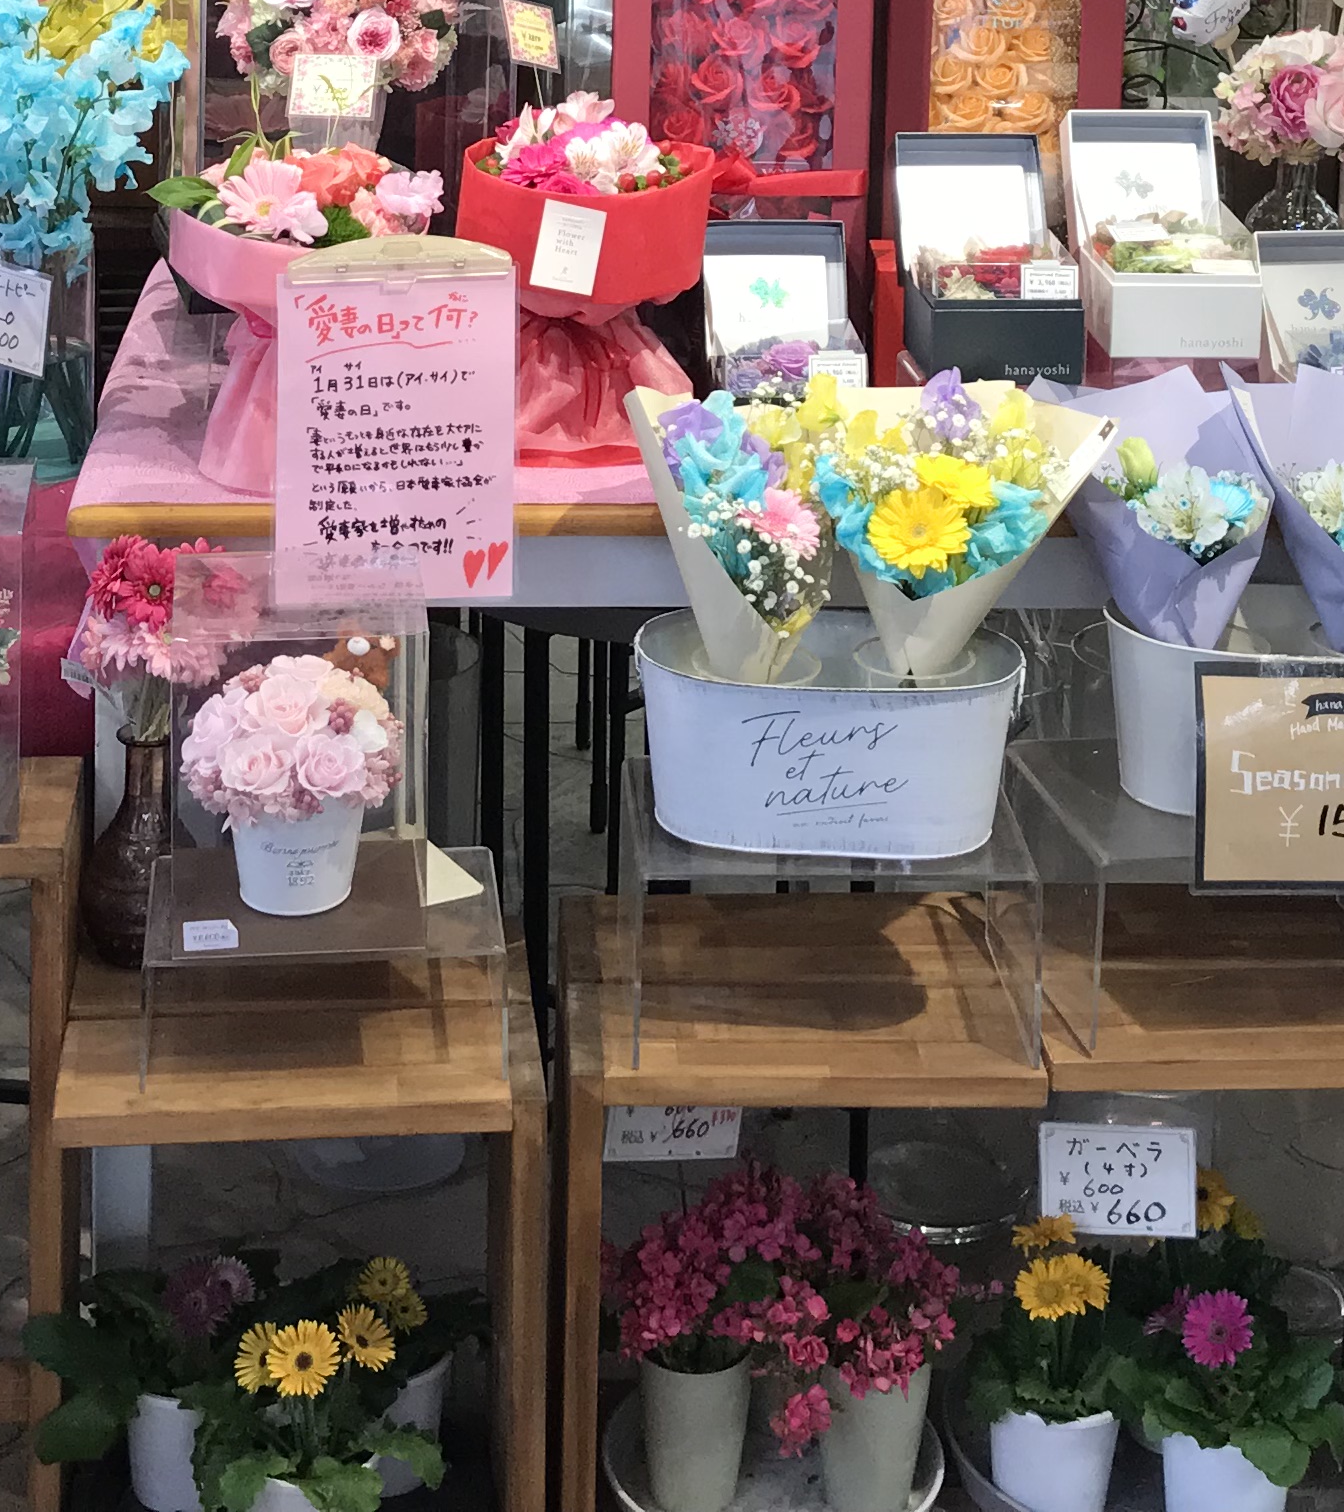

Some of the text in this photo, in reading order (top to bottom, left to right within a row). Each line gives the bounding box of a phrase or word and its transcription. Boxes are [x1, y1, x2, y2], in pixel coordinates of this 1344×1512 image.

[556, 239, 574, 247] with
[558, 229, 585, 241] Flower
[554, 246, 578, 256] Heart
[1178, 336, 1244, 351] hanayoshi
[1004, 364, 1070, 376] hanayoshi
[740, 709, 899, 767] Fleurs
[1290, 721, 1321, 740] Hand
[785, 749, 825, 781] et
[1229, 750, 1341, 796] Season
[763, 765, 910, 809] nature
[1278, 804, 1304, 848] ¥
[287, 875, 314, 886] 1852
[671, 1118, 710, 1139] 660
[1066, 1137, 1163, 1162] ガーベラ
[1059, 1171, 1124, 1197] ¥ 600
[1058, 1199, 1085, 1214] 税込
[1106, 1198, 1167, 1226] 660
